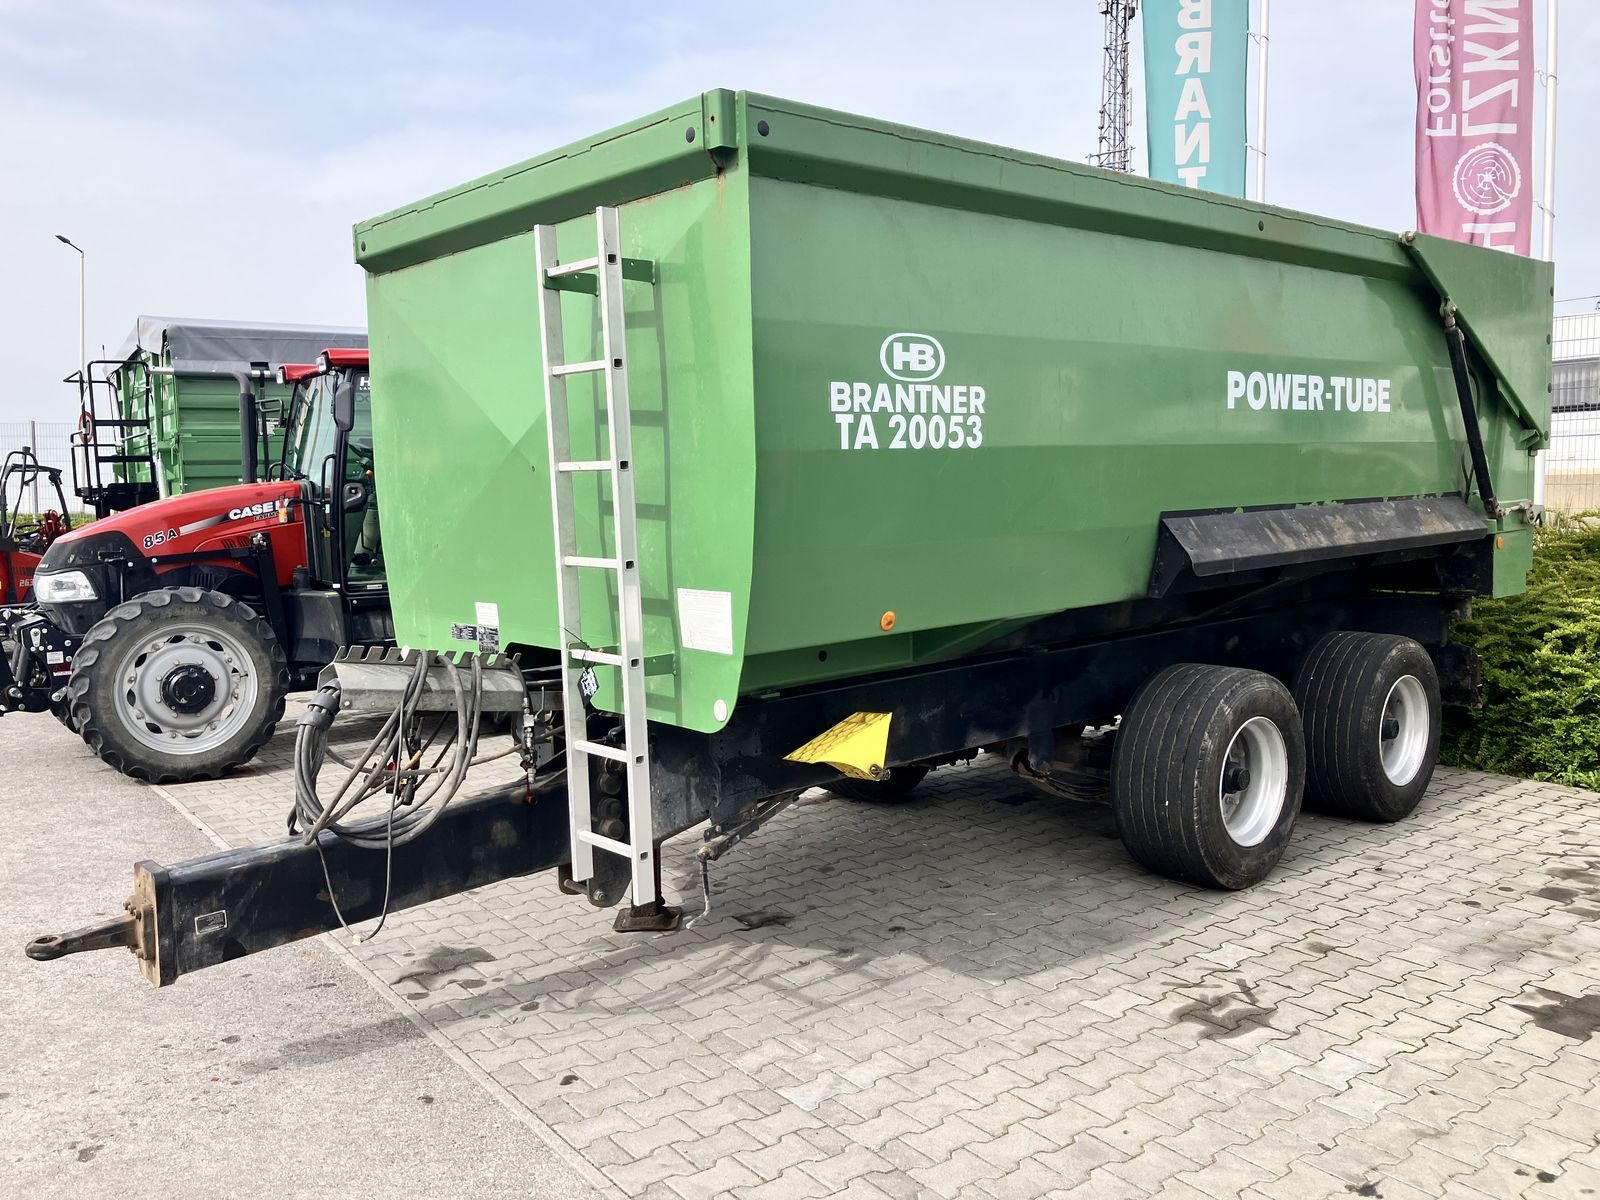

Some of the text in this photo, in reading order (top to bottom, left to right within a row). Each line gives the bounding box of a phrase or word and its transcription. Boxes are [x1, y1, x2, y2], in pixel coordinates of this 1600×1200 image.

[893, 342, 936, 371] HB
[830, 381, 986, 414] BRANTNER
[1227, 371, 1391, 413] POWER-TUBE
[835, 414, 983, 450] TA 20053
[229, 501, 274, 520] CASE
